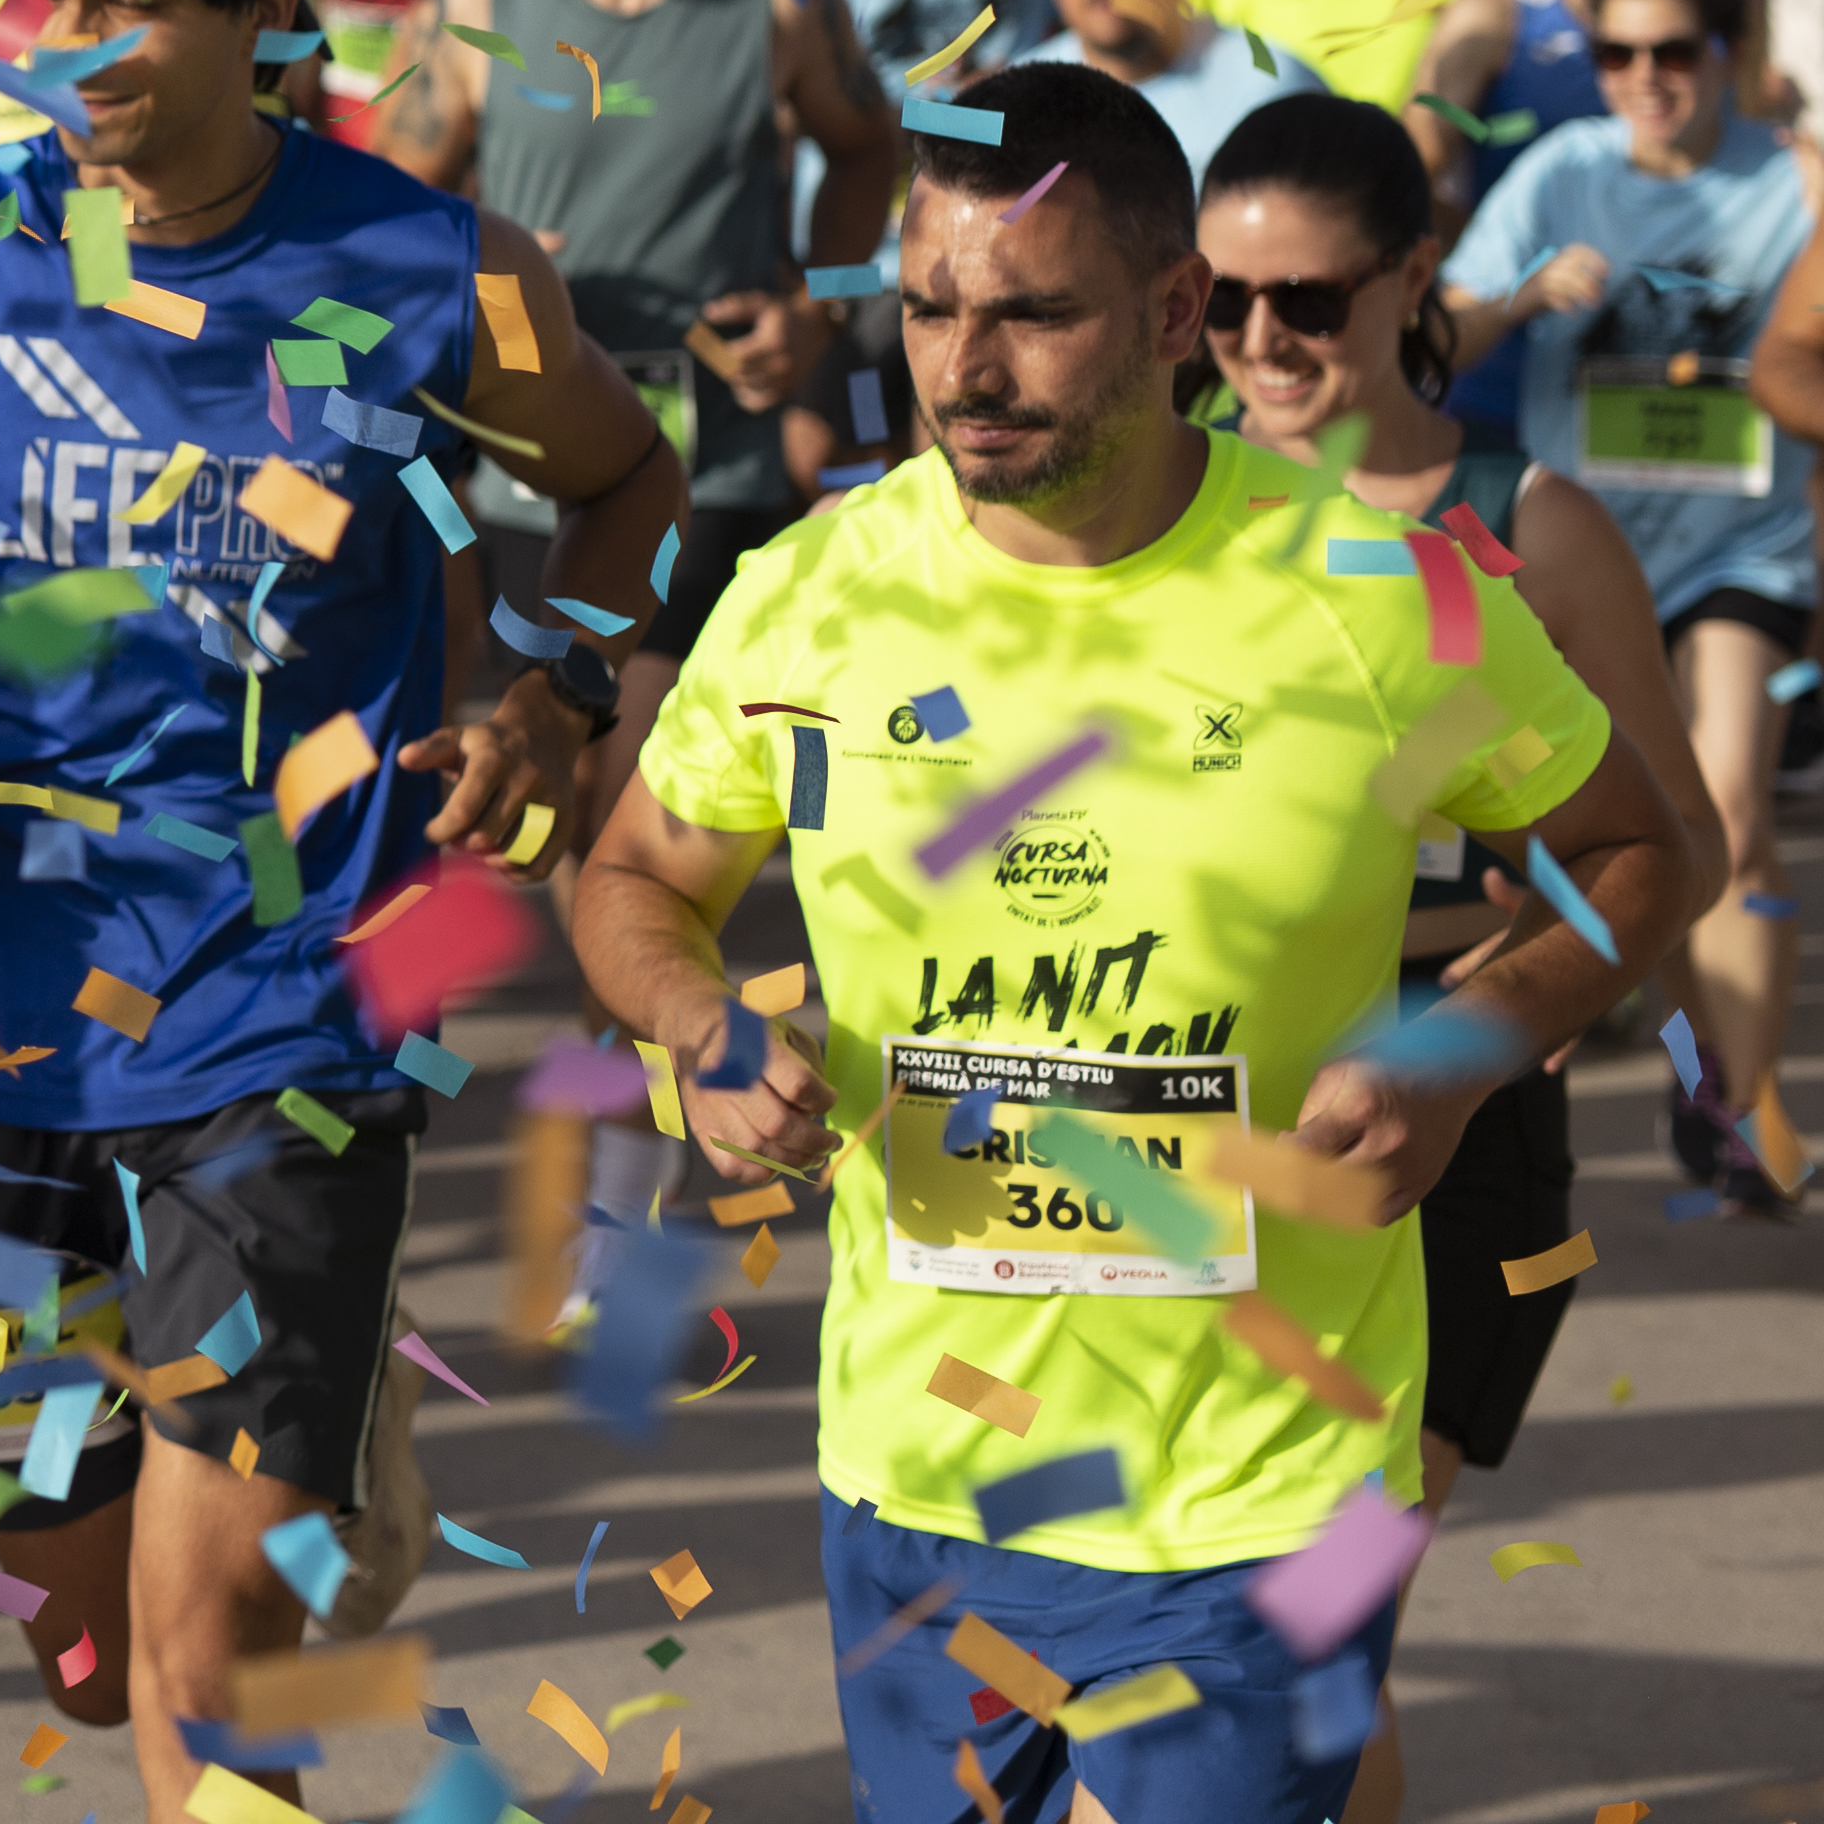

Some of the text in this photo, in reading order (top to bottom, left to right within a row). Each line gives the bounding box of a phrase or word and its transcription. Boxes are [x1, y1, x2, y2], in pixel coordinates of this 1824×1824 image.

[1005, 840, 1089, 865] CURSA
[993, 863, 1109, 888] NOCTURNA
[911, 956, 1001, 1036] LA
[895, 1048, 1115, 1087] XXVIII CURSA D'ESTIU
[895, 1068, 972, 1092] PREMIÀ
[1006, 1079, 1052, 1100] MAR
[1160, 1076, 1226, 1101] 10K
[952, 1127, 1183, 1172] CRISAN
[1005, 1182, 1125, 1233] 360
